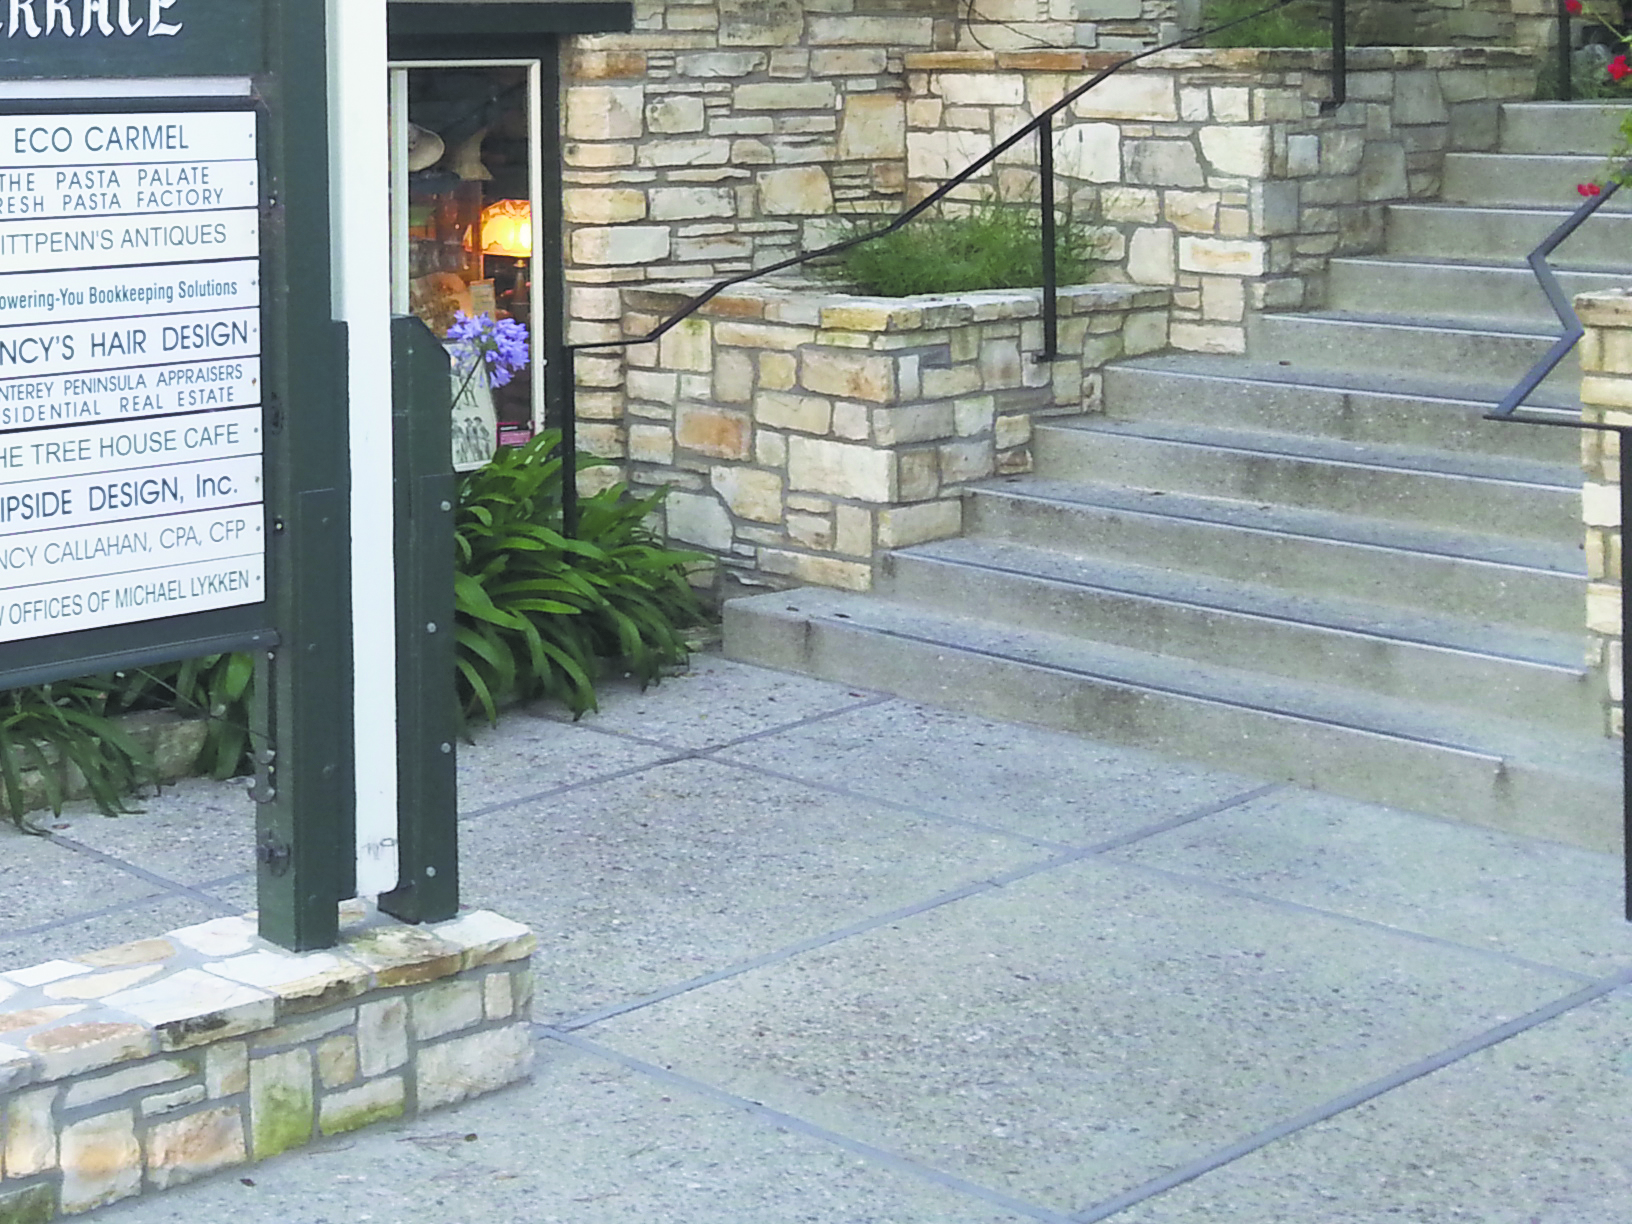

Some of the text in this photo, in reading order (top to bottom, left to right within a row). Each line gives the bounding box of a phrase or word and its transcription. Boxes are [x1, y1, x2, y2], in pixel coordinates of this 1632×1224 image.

[14, 124, 189, 153] ECO CARMEL
[57, 170, 120, 190] PASTA
[138, 167, 210, 187] PALATE
[63, 192, 121, 211] PASTA
[137, 188, 223, 208] FACTORY
[121, 223, 226, 249] ANTIQUES
[89, 284, 173, 304] Bookkeeping
[179, 279, 237, 298] Solutions
[91, 329, 147, 356] HAIR
[163, 320, 248, 351] DESIGN
[64, 373, 146, 396] PENINSULA
[156, 364, 243, 386] APPRAISERS
[120, 394, 163, 413] REAL
[178, 387, 235, 406] ESTATE
[31, 439, 91, 464] TREE
[99, 429, 177, 458] HOUSE
[184, 424, 239, 449] CAFE
[88, 477, 184, 512] DESIGN,
[196, 473, 238, 498] Inc.
[44, 532, 152, 564] CALLAHAN,
[160, 527, 202, 549] CPA,
[209, 519, 245, 543] CFP
[9, 595, 82, 625] OFFICES
[87, 591, 110, 612] OF
[115, 579, 187, 608] MICHAEL
[190, 570, 249, 595] LYKKEN
